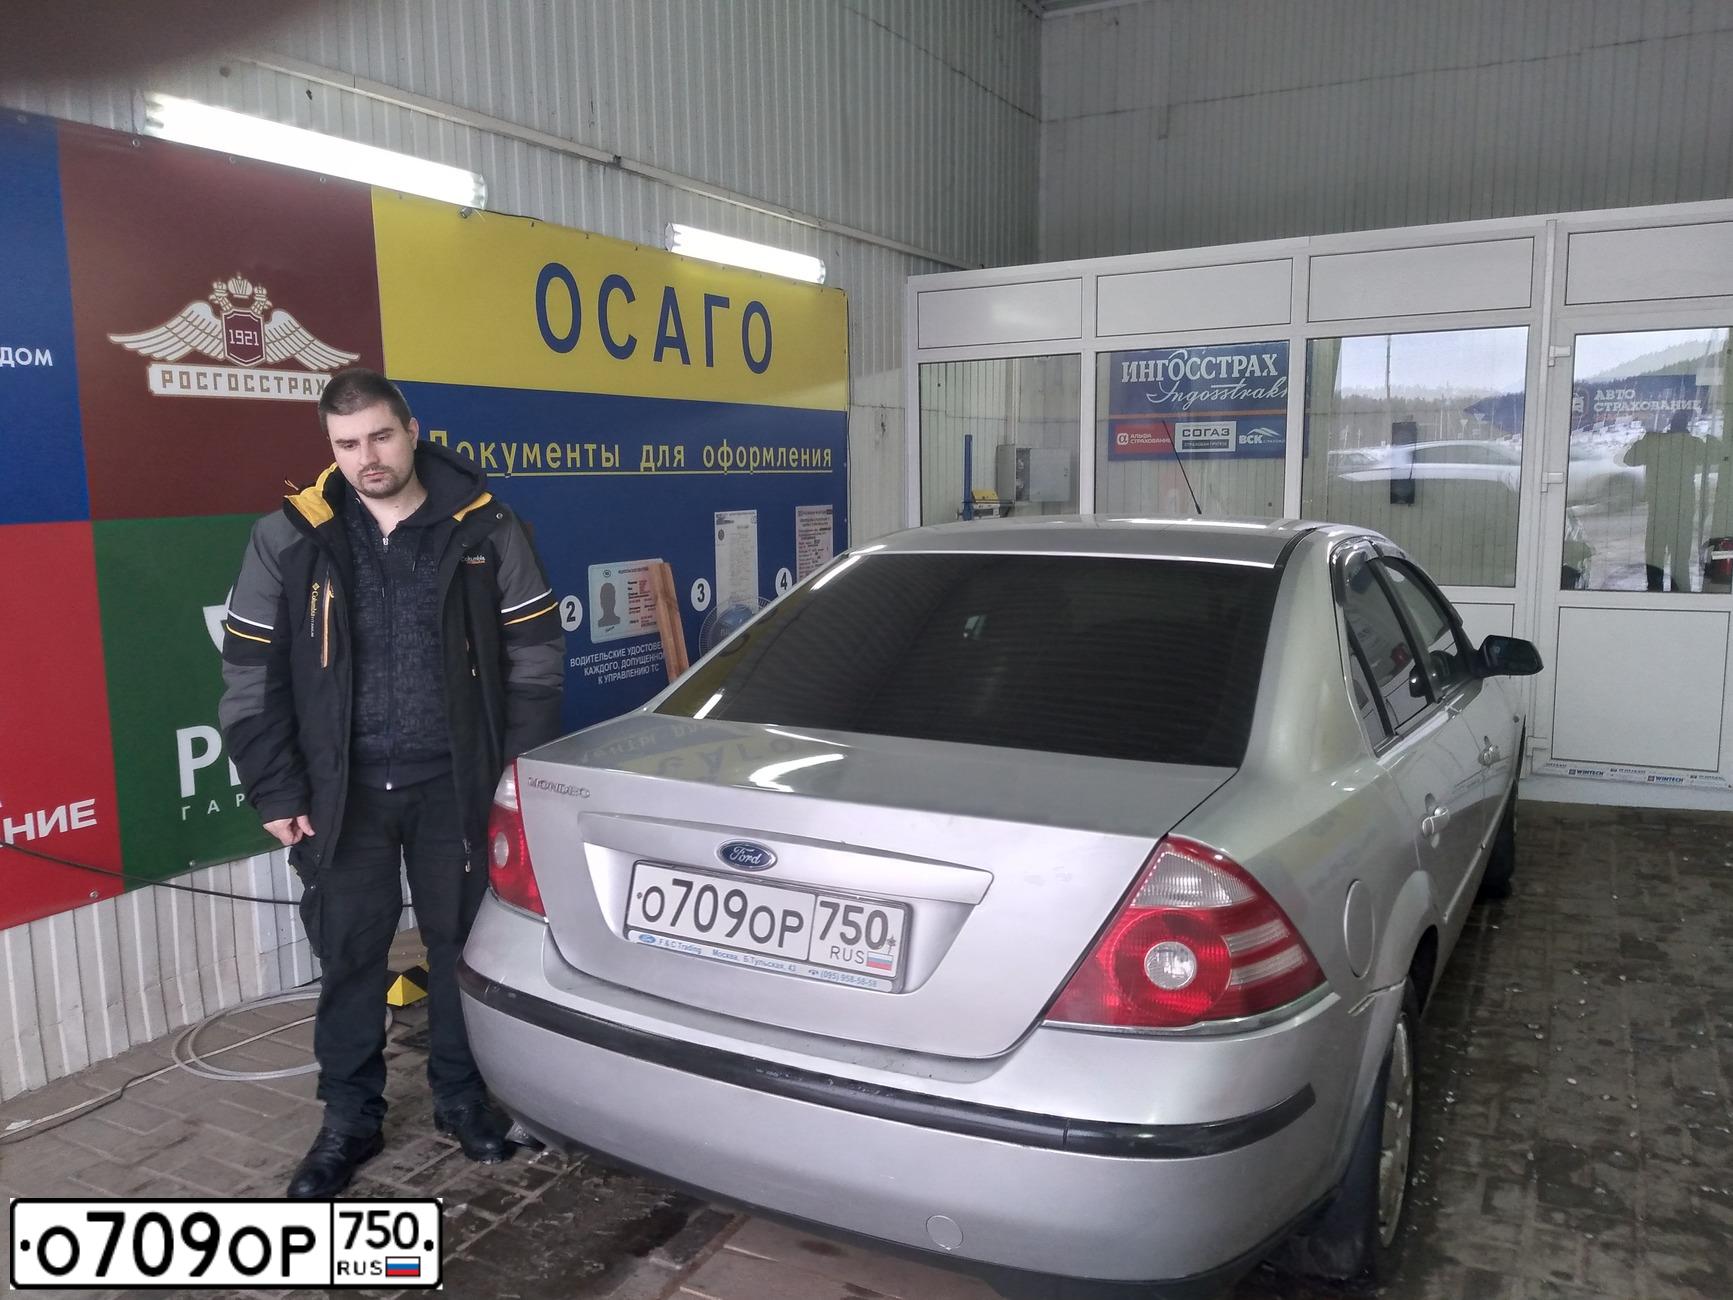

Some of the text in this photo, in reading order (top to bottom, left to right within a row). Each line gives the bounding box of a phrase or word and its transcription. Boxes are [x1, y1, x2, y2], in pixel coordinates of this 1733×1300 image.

[535, 262, 772, 374] ОСАГО
[229, 329, 260, 346] 1921
[0, 346, 54, 368] ДОМ
[1121, 350, 1278, 383] ИНГОССТРАХ
[161, 369, 326, 396] РОСГОССТРАХ
[1594, 389, 1636, 400] АВТО
[1182, 428, 1230, 437] СОГАЗ
[1239, 434, 1263, 445] ВСК
[640, 444, 685, 472] для
[703, 439, 832, 476] оформления
[780, 572, 788, 590] 4
[697, 583, 706, 603] 3
[565, 601, 576, 623] 2
[570, 648, 626, 668] ВОДИТЕЛЬСКИЕ
[730, 846, 762, 864] Ford
[819, 900, 888, 950] 750
[829, 945, 865, 965] RUS
